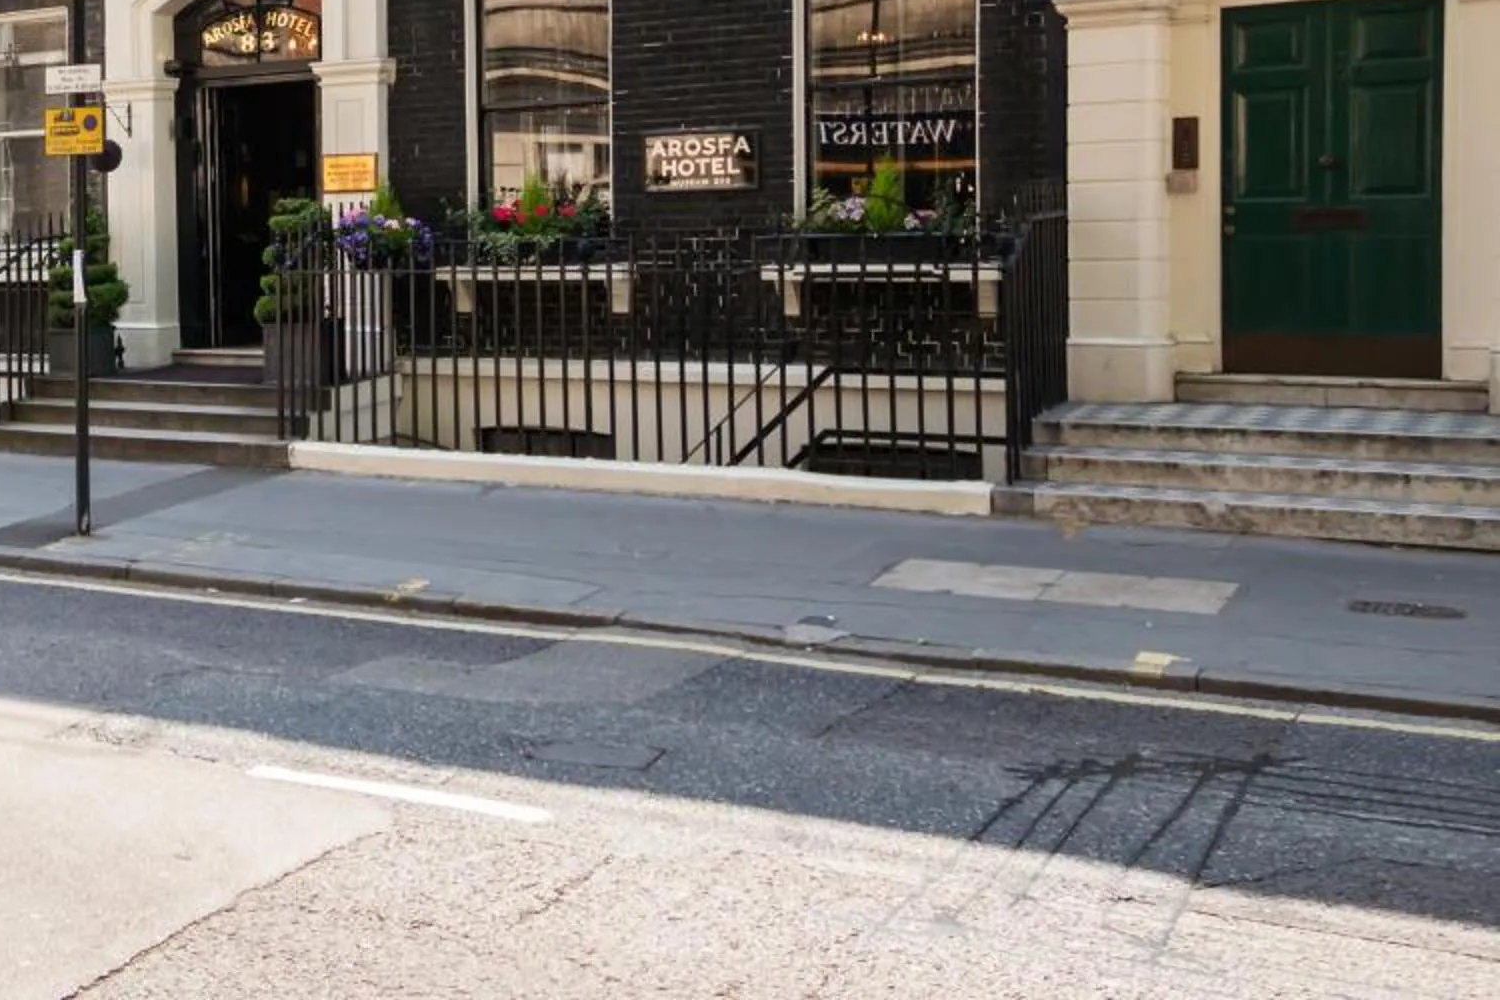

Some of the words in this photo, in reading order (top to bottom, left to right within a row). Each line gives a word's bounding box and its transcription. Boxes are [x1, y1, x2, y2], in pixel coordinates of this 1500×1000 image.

[266, 10, 314, 37] HOTEL
[651, 135, 751, 157] AROSFA
[661, 156, 741, 177] HOTEL
